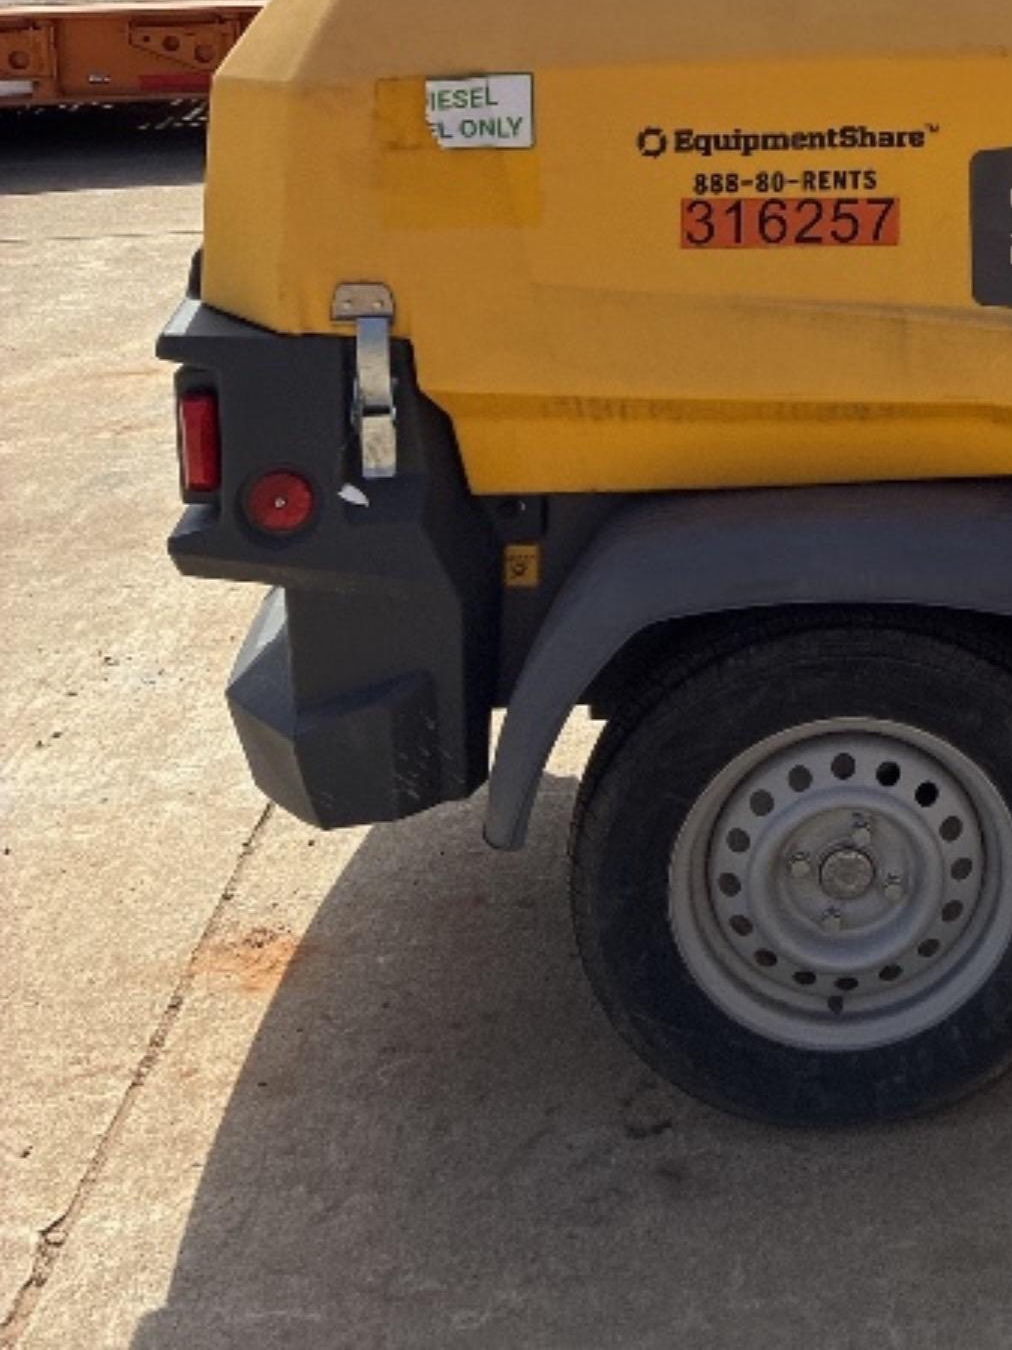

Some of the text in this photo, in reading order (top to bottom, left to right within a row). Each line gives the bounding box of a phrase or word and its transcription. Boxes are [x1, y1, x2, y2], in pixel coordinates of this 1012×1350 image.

[426, 87, 499, 111] IESEL
[460, 116, 523, 138] ONLY
[694, 170, 878, 195] 888-80-RENTS
[685, 198, 896, 246] 316257
